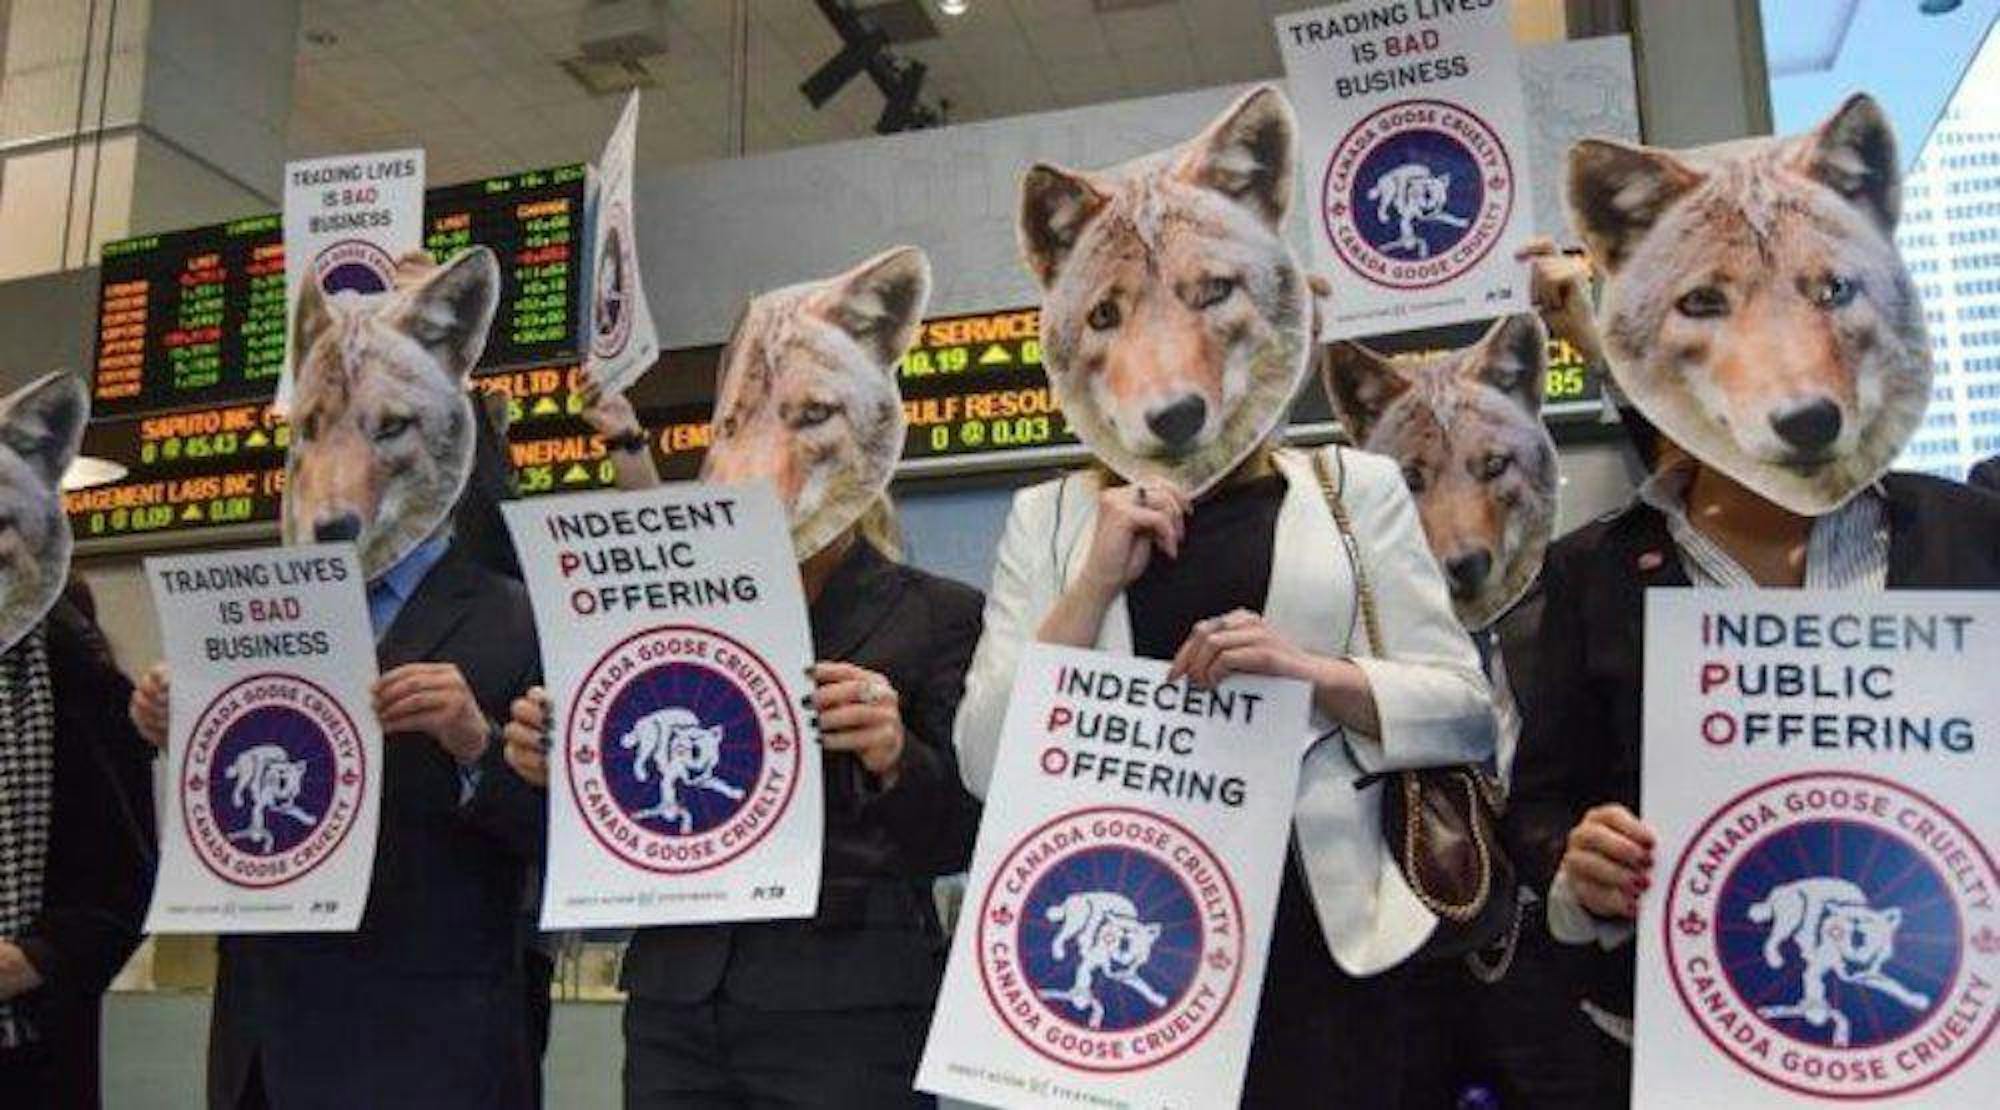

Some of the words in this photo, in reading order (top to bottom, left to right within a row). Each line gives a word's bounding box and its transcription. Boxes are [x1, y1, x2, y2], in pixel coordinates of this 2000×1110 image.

[1289, 2, 1408, 45] TRADING
[1351, 42, 1378, 64] IS
[1384, 29, 1439, 57] BAD
[1336, 55, 1469, 99] BUSINESS
[1379, 109, 1435, 130] GOOSE
[293, 164, 362, 186] TRADING
[368, 160, 416, 180] LIVES
[342, 188, 378, 206] BAD
[309, 209, 392, 233] BUSINESS
[1545, 367, 1584, 397] 85
[141, 411, 220, 440] SAPUTO
[222, 406, 257, 430] INC
[932, 426, 950, 450] 0
[167, 475, 221, 503] LABS
[223, 472, 256, 497] INC
[546, 500, 736, 542] INDECENT
[160, 563, 270, 595] TRADING
[276, 557, 348, 585] LIVES
[560, 542, 696, 578] PUBLIC
[219, 601, 244, 624] IS
[248, 596, 301, 622] BAD
[572, 575, 758, 615] OFFERING
[205, 630, 330, 662] BUSINESS
[1702, 613, 1975, 651] INDECENT
[580, 657, 635, 732] CANADA
[640, 638, 709, 661] GOOSE
[713, 648, 781, 723] CRUELTY
[1056, 666, 1264, 725] INDECENT
[1700, 663, 1895, 700] PUBLIC
[195, 701, 239, 764] CANADA
[243, 683, 298, 702] GOOSE
[303, 694, 354, 759] CRUELTY
[1047, 706, 1197, 756] PUBLIC
[1701, 711, 1976, 751] OFFERING
[1040, 747, 1247, 807] OFFERING
[583, 780, 640, 851] CANADA
[645, 842, 716, 861] GOOSE
[720, 767, 785, 848] CRUELTY
[192, 803, 229, 866] CANADA
[235, 861, 288, 877] GOOSE
[1690, 804, 1778, 896] CANADA
[1785, 788, 1891, 818] GOOSE
[1897, 808, 1992, 912] CRUELTY
[1005, 826, 1086, 895] CANADA
[1091, 819, 1172, 850] GOOSE
[1172, 845, 1231, 937] CRUELTY
[991, 941, 1042, 1033] CANADA
[1044, 1026, 1124, 1062] GOOSE
[1131, 983, 1217, 1055] CRUELTY
[1687, 956, 1773, 1058] CANADA
[1781, 1054, 1889, 1083] GOOSE
[1896, 972, 1993, 1074] CRUELTY
